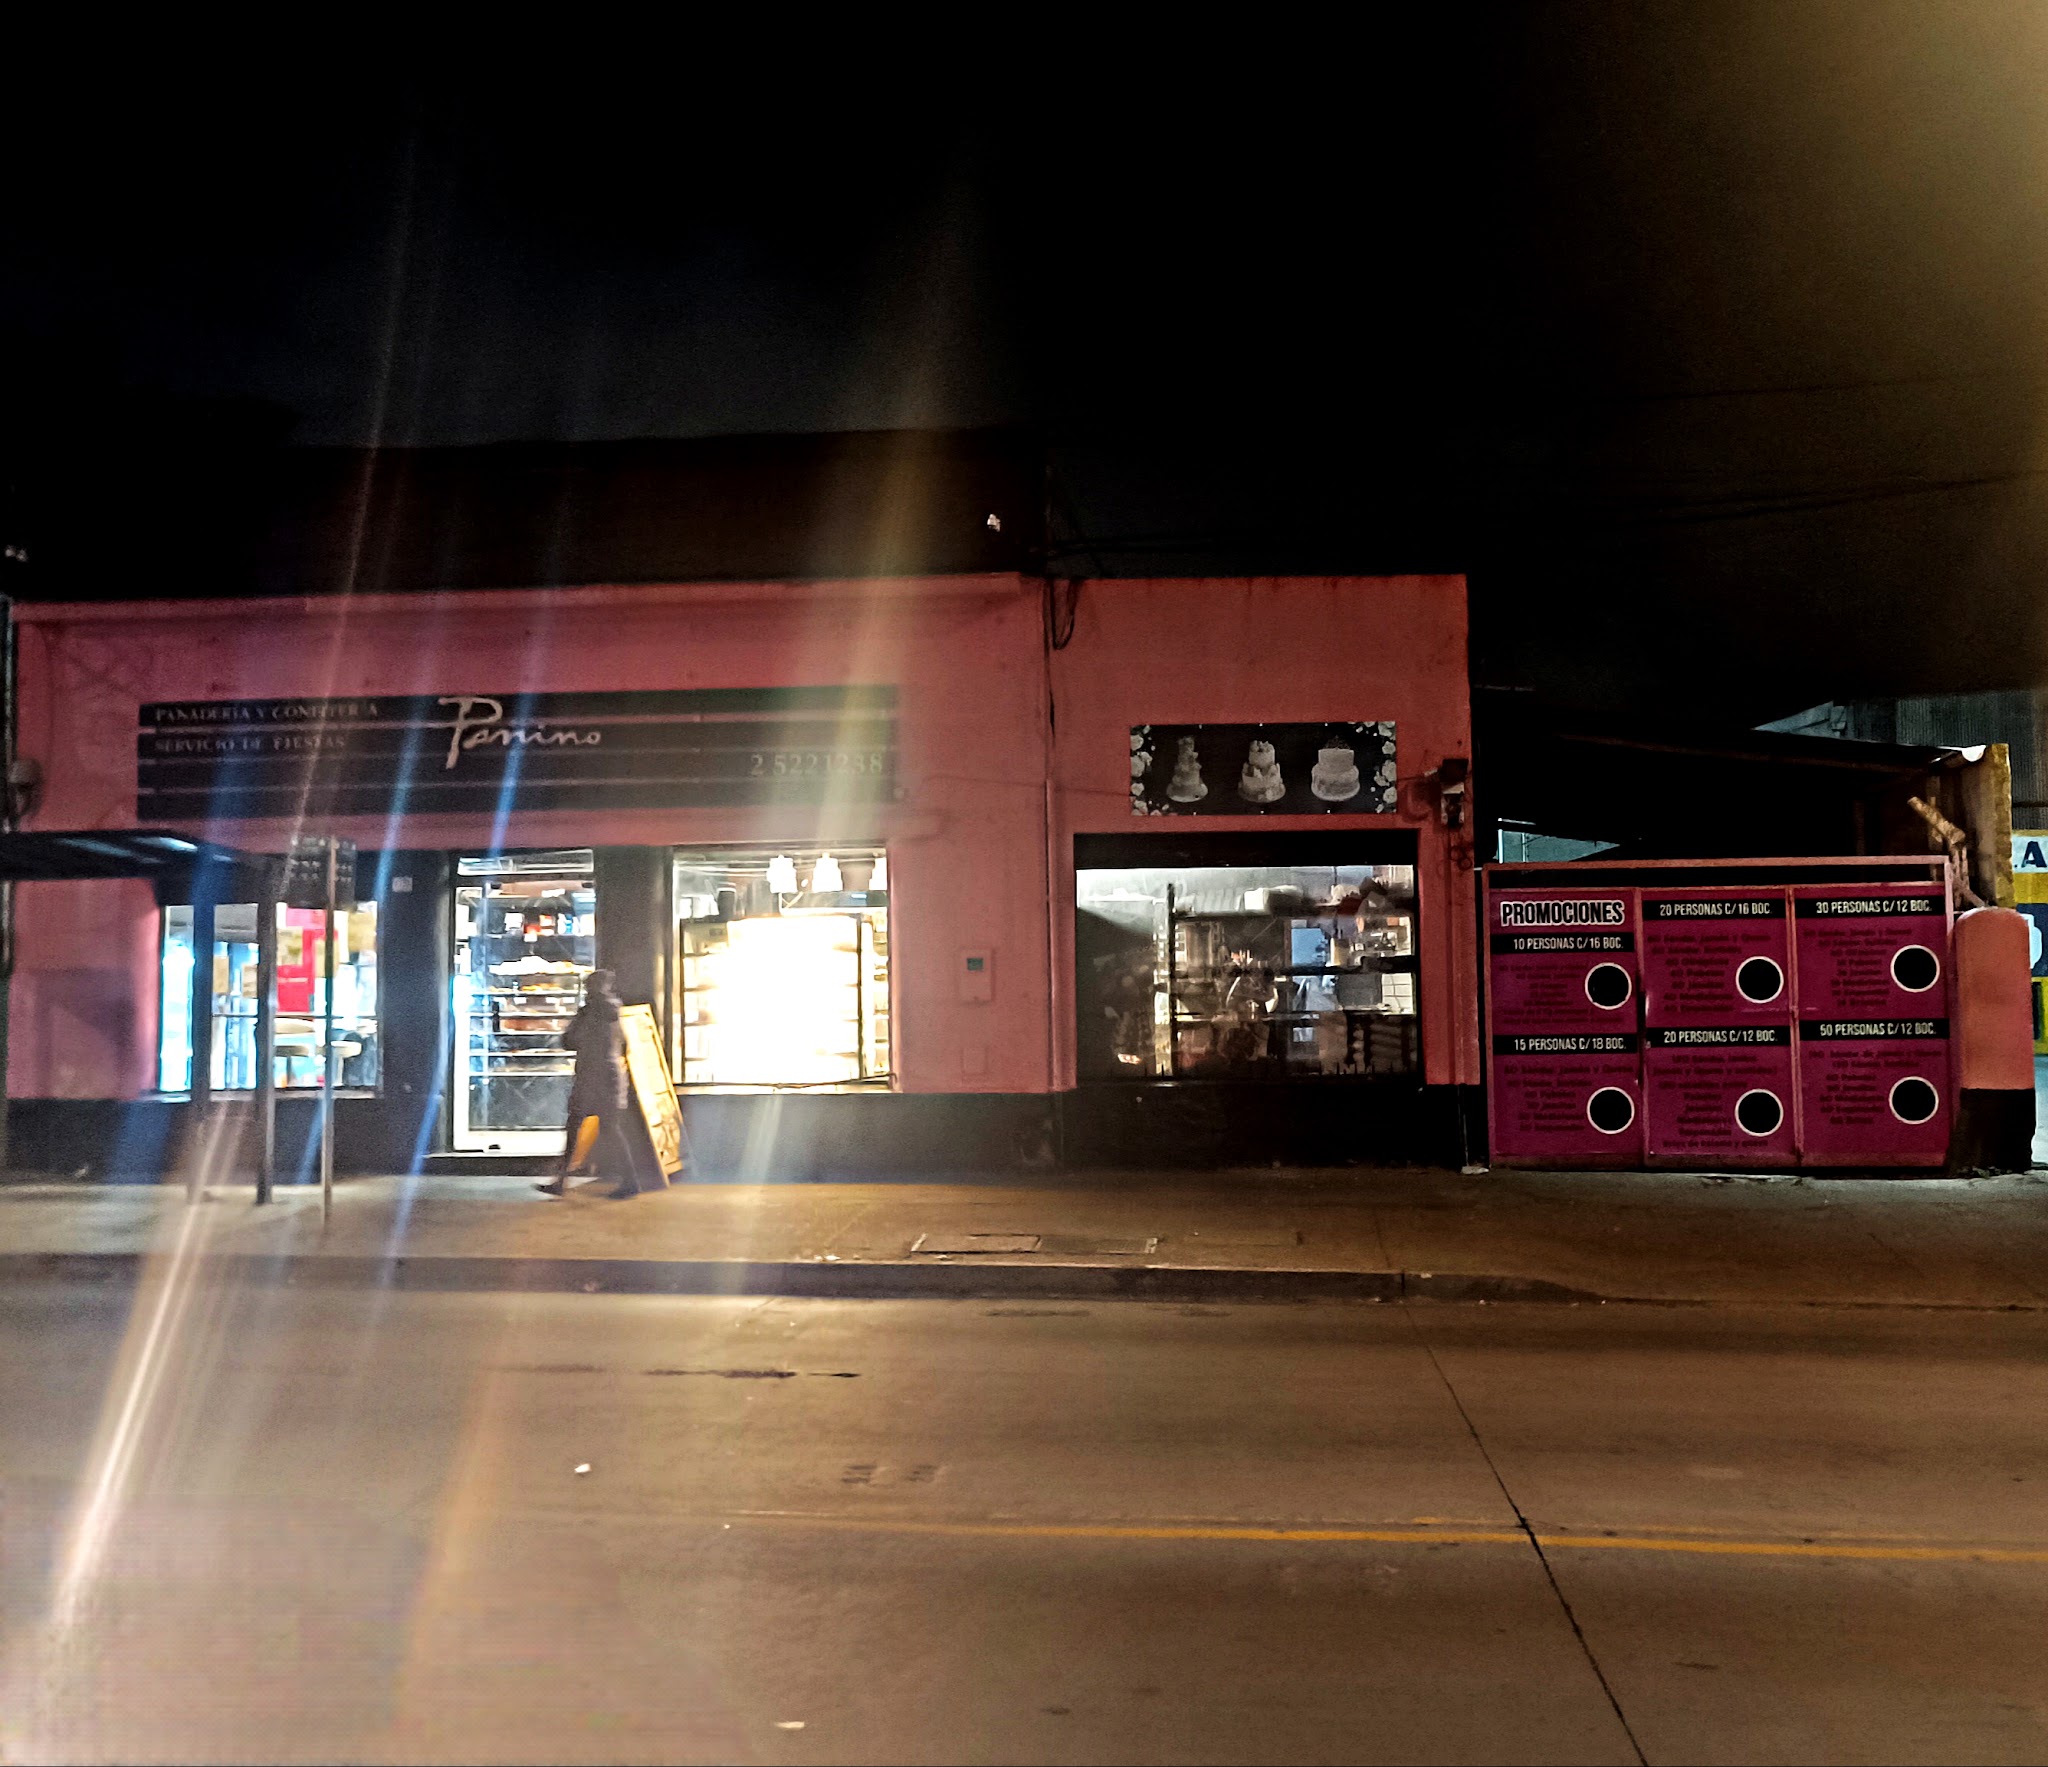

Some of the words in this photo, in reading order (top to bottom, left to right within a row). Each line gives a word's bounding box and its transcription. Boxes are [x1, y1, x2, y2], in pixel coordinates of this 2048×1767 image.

[271, 702, 378, 719] CONFITERA
[438, 696, 601, 769] Panino
[750, 753, 765, 777] 2
[1500, 899, 1625, 927] PROMOCIONES
[1660, 903, 1672, 916] 20
[1674, 902, 1723, 916] PERSONAS
[1816, 902, 1829, 914] 30
[1831, 901, 1880, 914] PERSONAS
[1513, 938, 1525, 950] 10
[1527, 936, 1575, 950] PERSONAS
[1664, 1031, 1677, 1044] 20
[1678, 1029, 1728, 1043] PERSONAS
[1820, 1024, 1833, 1036] 50
[1835, 1022, 1885, 1036] PERSONAS
[1514, 1038, 1527, 1052] 15
[1528, 1037, 1577, 1051] PERSONAS
